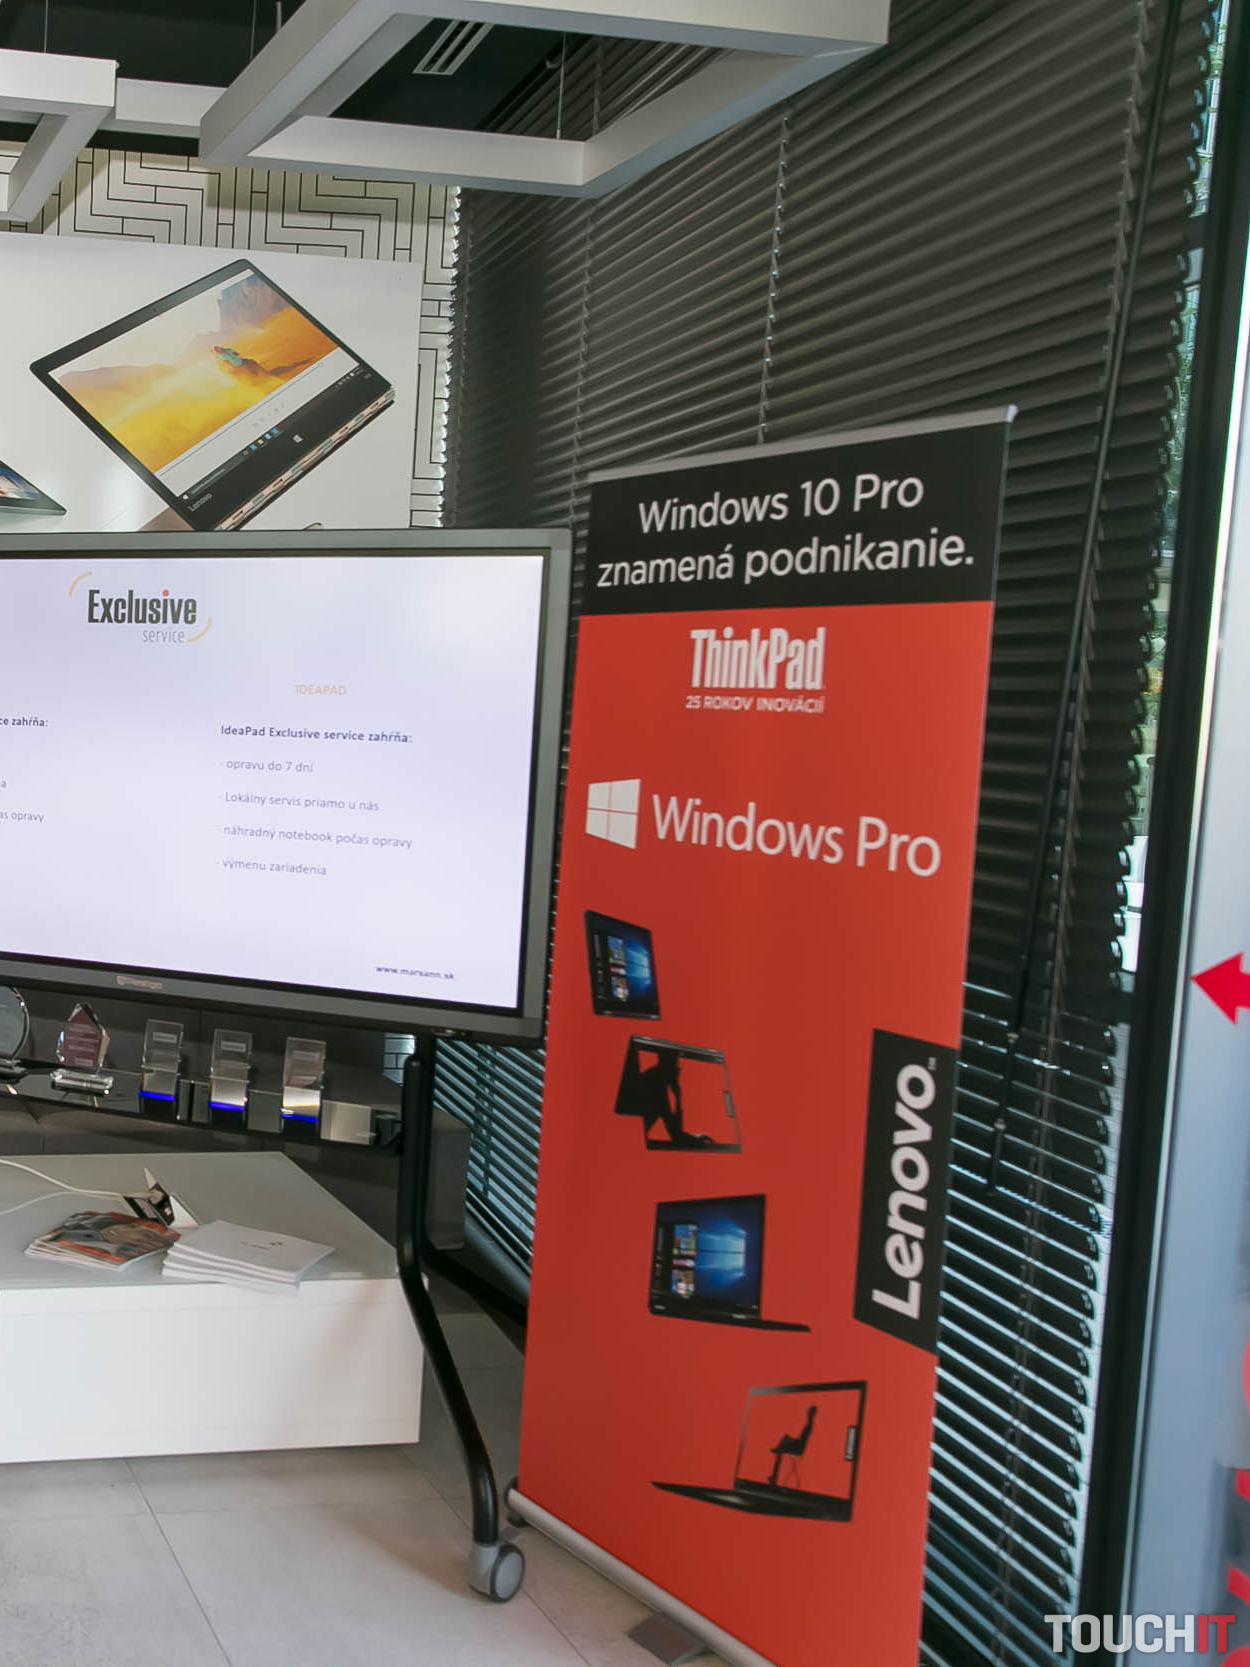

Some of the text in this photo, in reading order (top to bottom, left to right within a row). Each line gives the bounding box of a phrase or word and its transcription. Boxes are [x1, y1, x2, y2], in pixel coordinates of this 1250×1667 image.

[638, 473, 924, 534] Windows 10 Pro
[597, 526, 975, 588] znamená podnikanie.
[88, 589, 197, 625] Exclusive
[142, 630, 186, 644] service
[690, 626, 826, 690] ThinkPad
[295, 684, 347, 696] IDEAPAD
[686, 694, 826, 713] 25 ROKOV INOVÁCIÍ
[221, 725, 266, 738] IdeaPad
[269, 727, 320, 740] Exclusive
[324, 730, 364, 741] service
[226, 760, 314, 774] opravu do 7 dní
[225, 791, 380, 812] Lokálny servis priamo u nás
[11, 812, 45, 823] opravy
[223, 825, 413, 850] náhradný notebook počas opravy
[652, 794, 942, 877] Windows Pro
[222, 858, 327, 876] výmenu zariadenia
